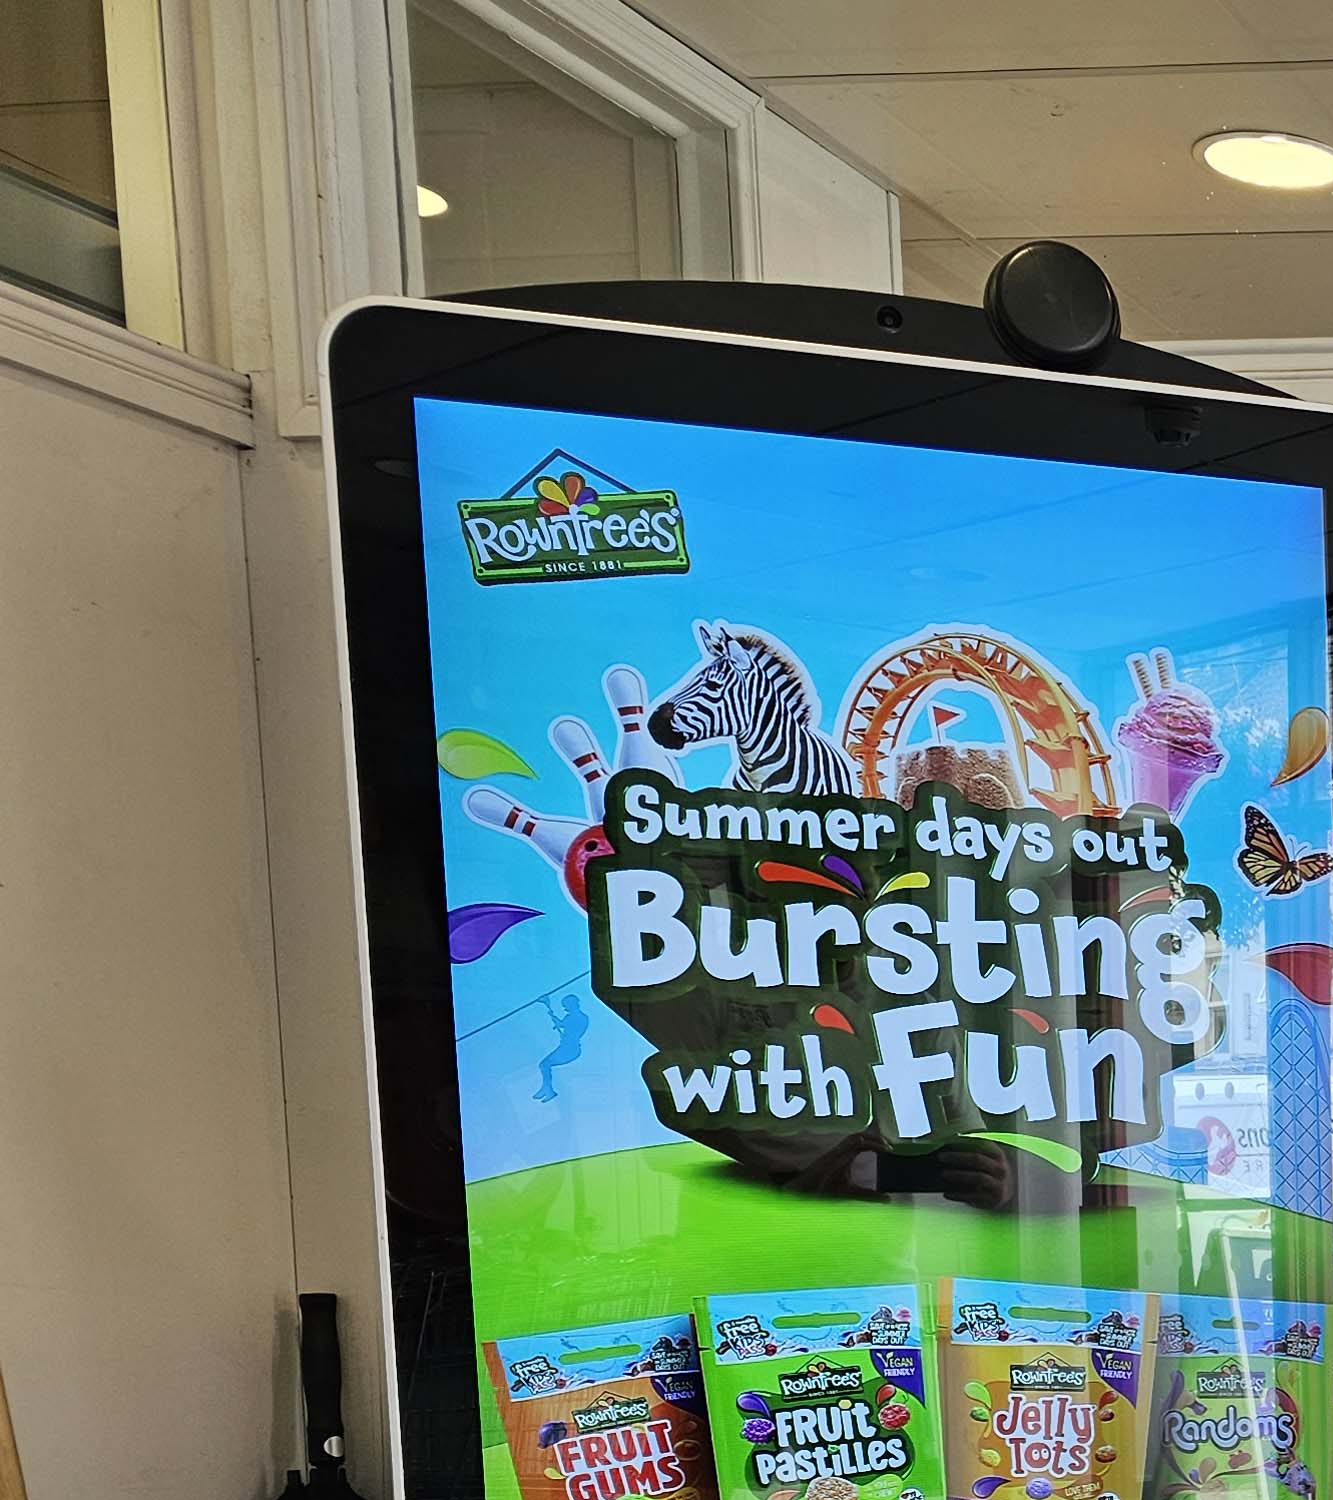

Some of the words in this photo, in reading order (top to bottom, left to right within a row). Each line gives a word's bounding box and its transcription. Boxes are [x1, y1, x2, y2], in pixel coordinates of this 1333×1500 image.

[545, 562, 586, 574] SINCE
[592, 560, 623, 571] 1881
[623, 785, 896, 852] Summer
[915, 796, 1068, 881] days
[1071, 818, 1171, 870] out
[605, 869, 1210, 1044] Bursting
[662, 1034, 855, 1119] with
[871, 999, 1146, 1139] Fun
[1096, 1352, 1132, 1370] VEGAN
[1100, 1370, 1132, 1379] FRIENDLY
[996, 1395, 1095, 1440] Jelly
[1163, 1405, 1295, 1452] Randoms
[1010, 1436, 1088, 1477] Tots
